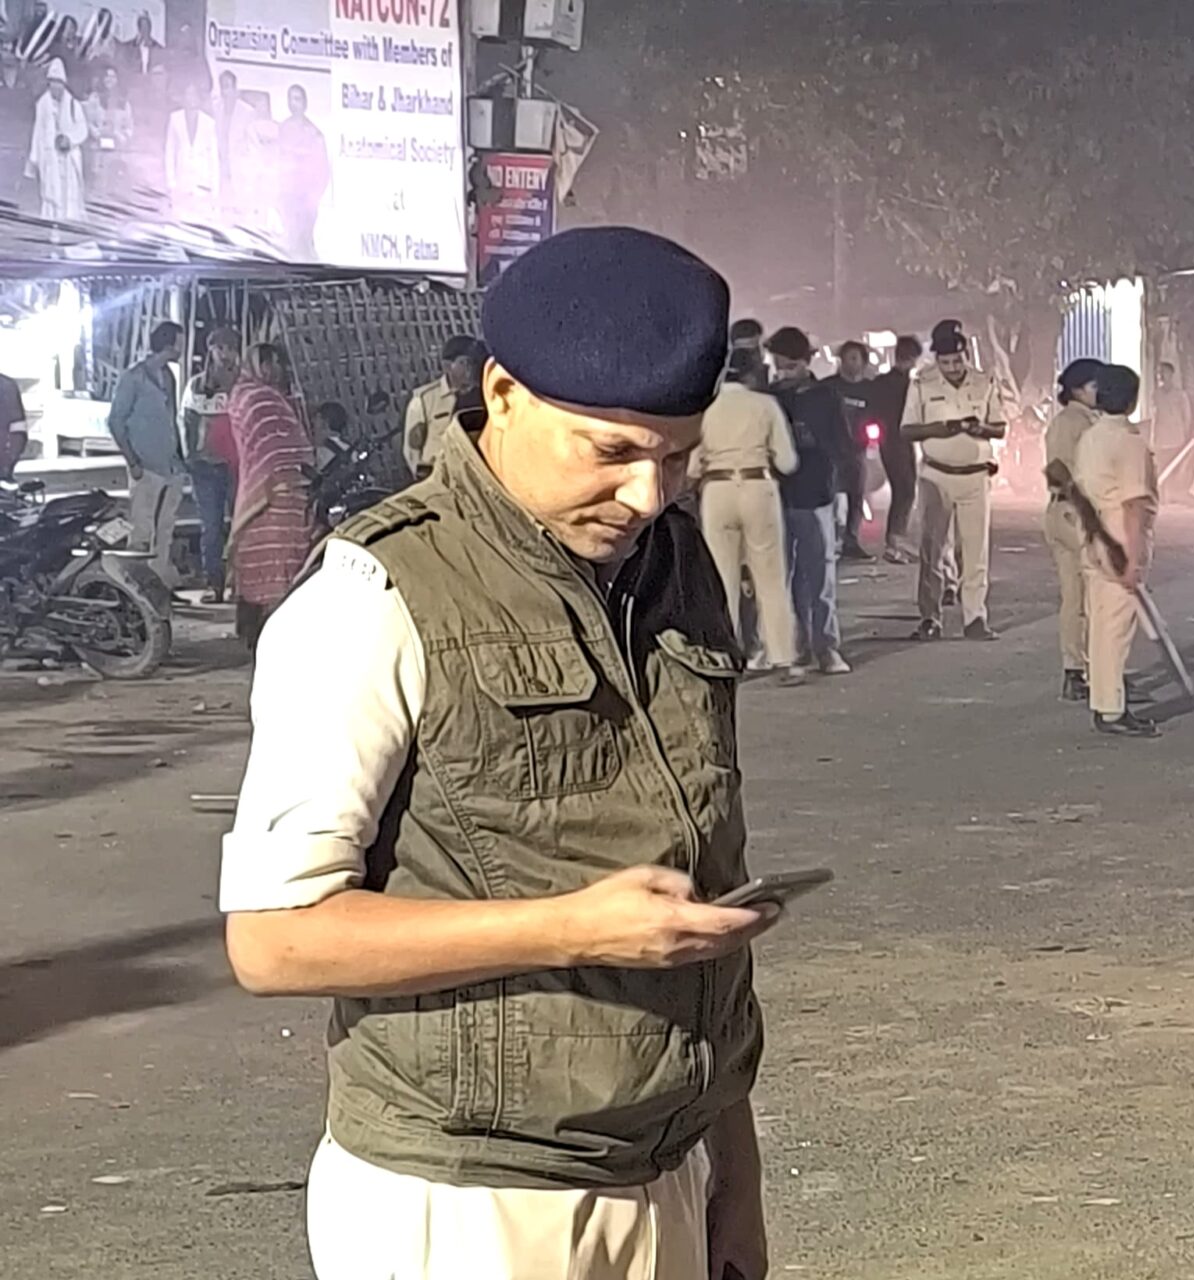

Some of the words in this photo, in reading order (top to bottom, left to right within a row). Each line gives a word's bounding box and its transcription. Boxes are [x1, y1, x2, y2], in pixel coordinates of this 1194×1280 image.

[208, 21, 277, 59] Organising
[281, 27, 349, 59] Committee
[352, 34, 379, 61] with
[382, 37, 438, 67] Members
[440, 42, 453, 68] of
[341, 82, 374, 110] Bihar
[377, 85, 387, 111] &
[391, 86, 454, 115] Jharkhand
[339, 134, 406, 161] Anatomical
[410, 136, 457, 171] Society
[405, 234, 440, 260] Patna
